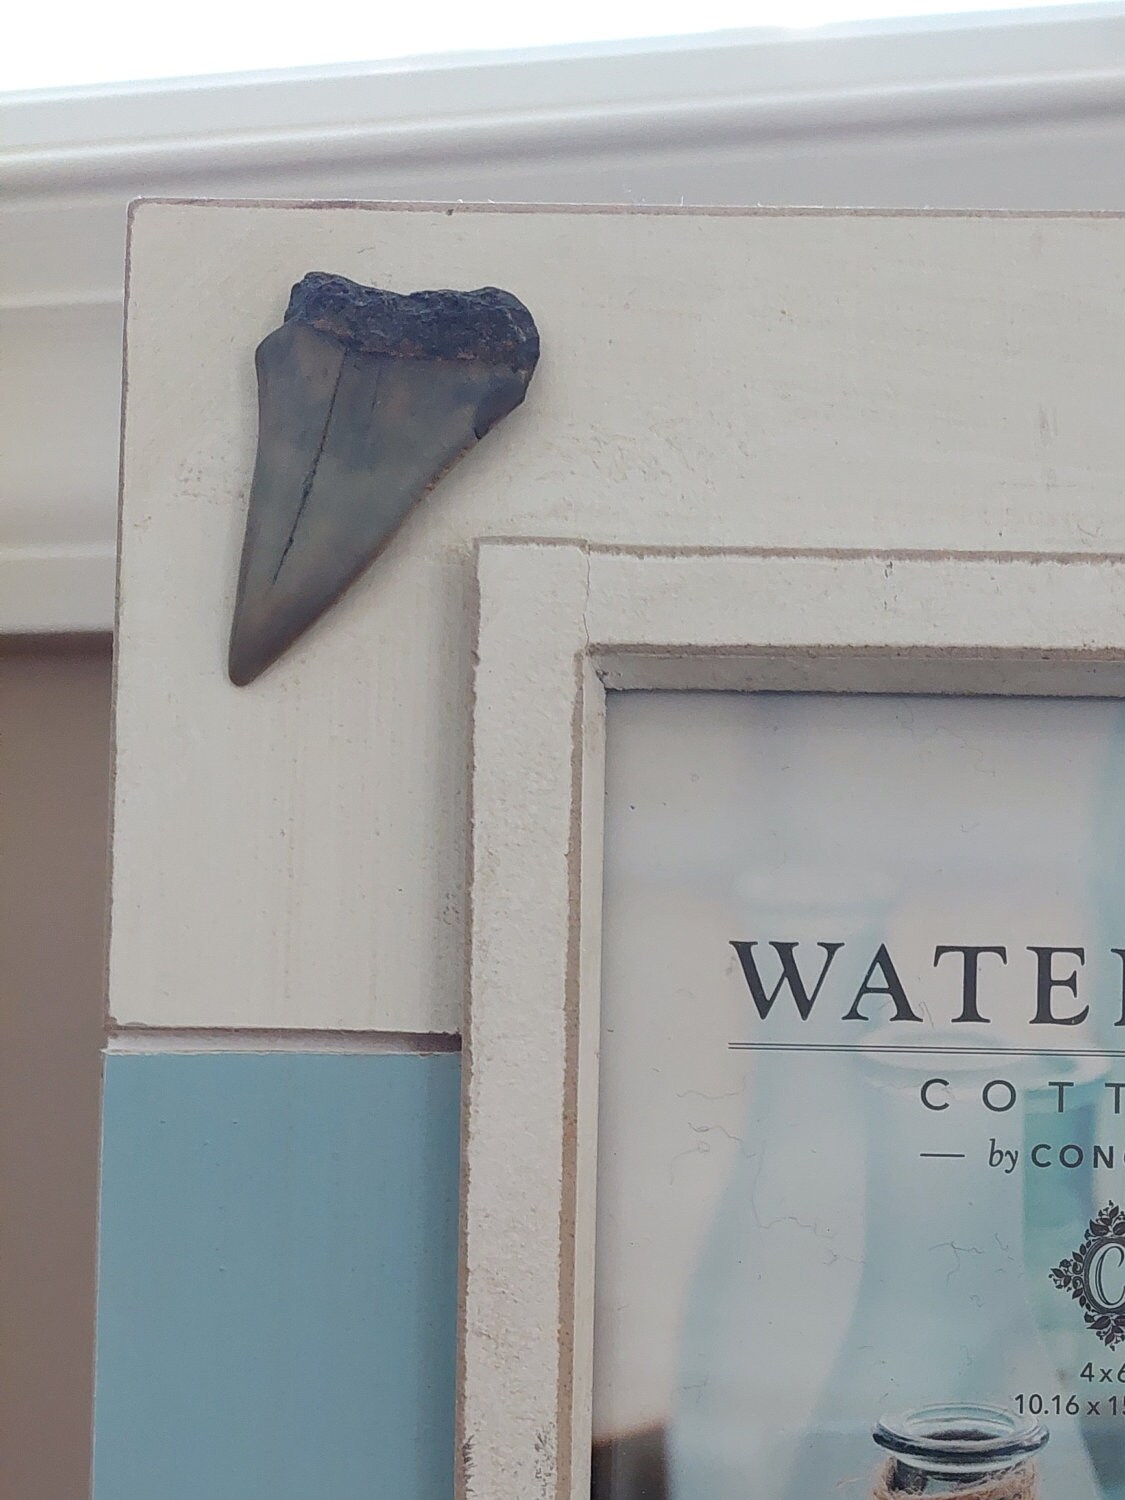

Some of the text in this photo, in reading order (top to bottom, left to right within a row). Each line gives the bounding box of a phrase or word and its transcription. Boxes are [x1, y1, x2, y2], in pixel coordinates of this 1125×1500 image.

[988, 1138, 1019, 1174] by
[1014, 1393, 1081, 1416] 10.16
[1086, 1400, 1101, 1417] x
